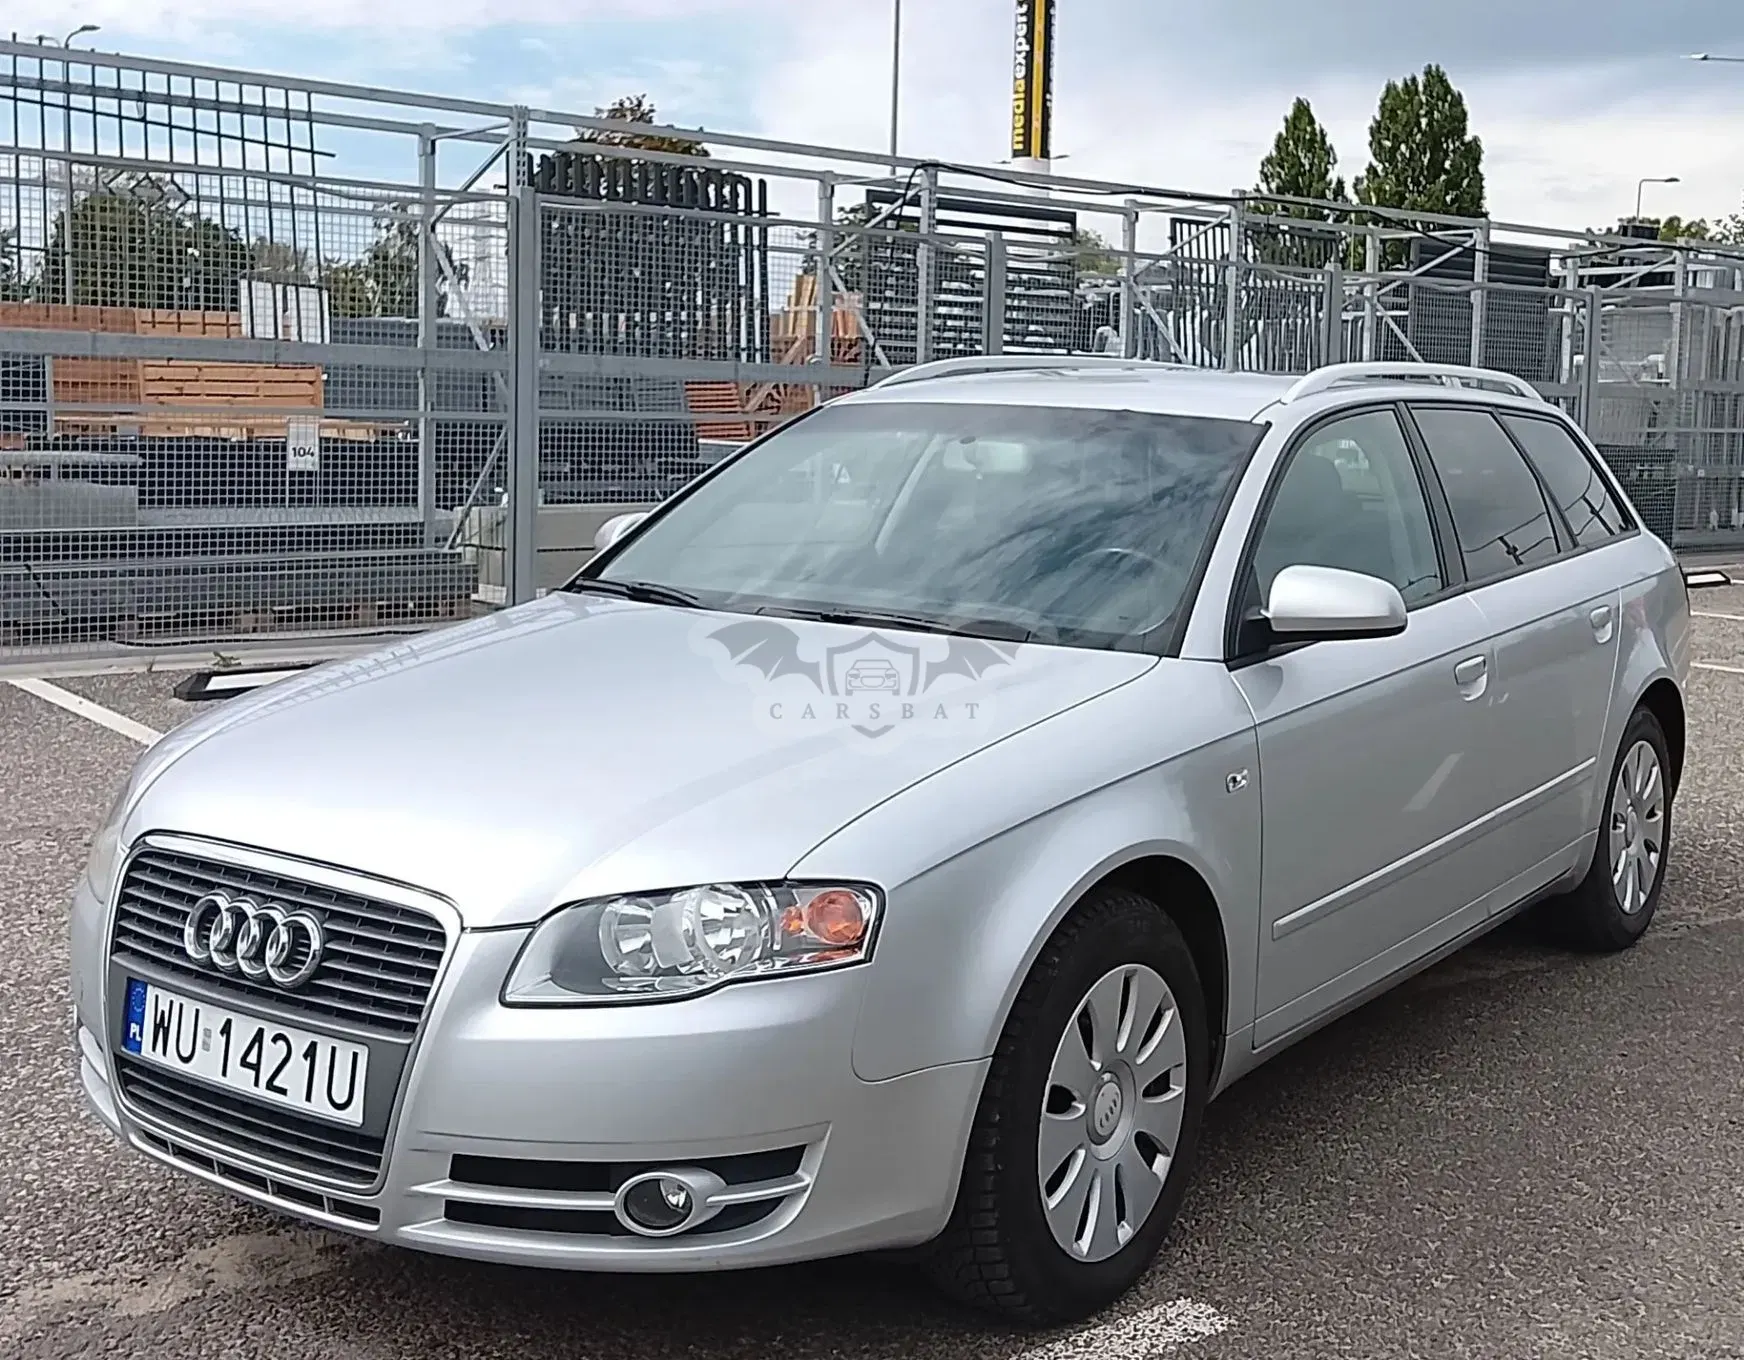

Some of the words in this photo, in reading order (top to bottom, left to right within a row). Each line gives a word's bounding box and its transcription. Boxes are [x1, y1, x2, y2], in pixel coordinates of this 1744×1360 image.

[1013, 3, 1030, 150] mediaexpert
[292, 446, 315, 458] 104
[129, 1022, 142, 1042] PL
[152, 993, 200, 1064] WU
[219, 1017, 359, 1111] 1421U
